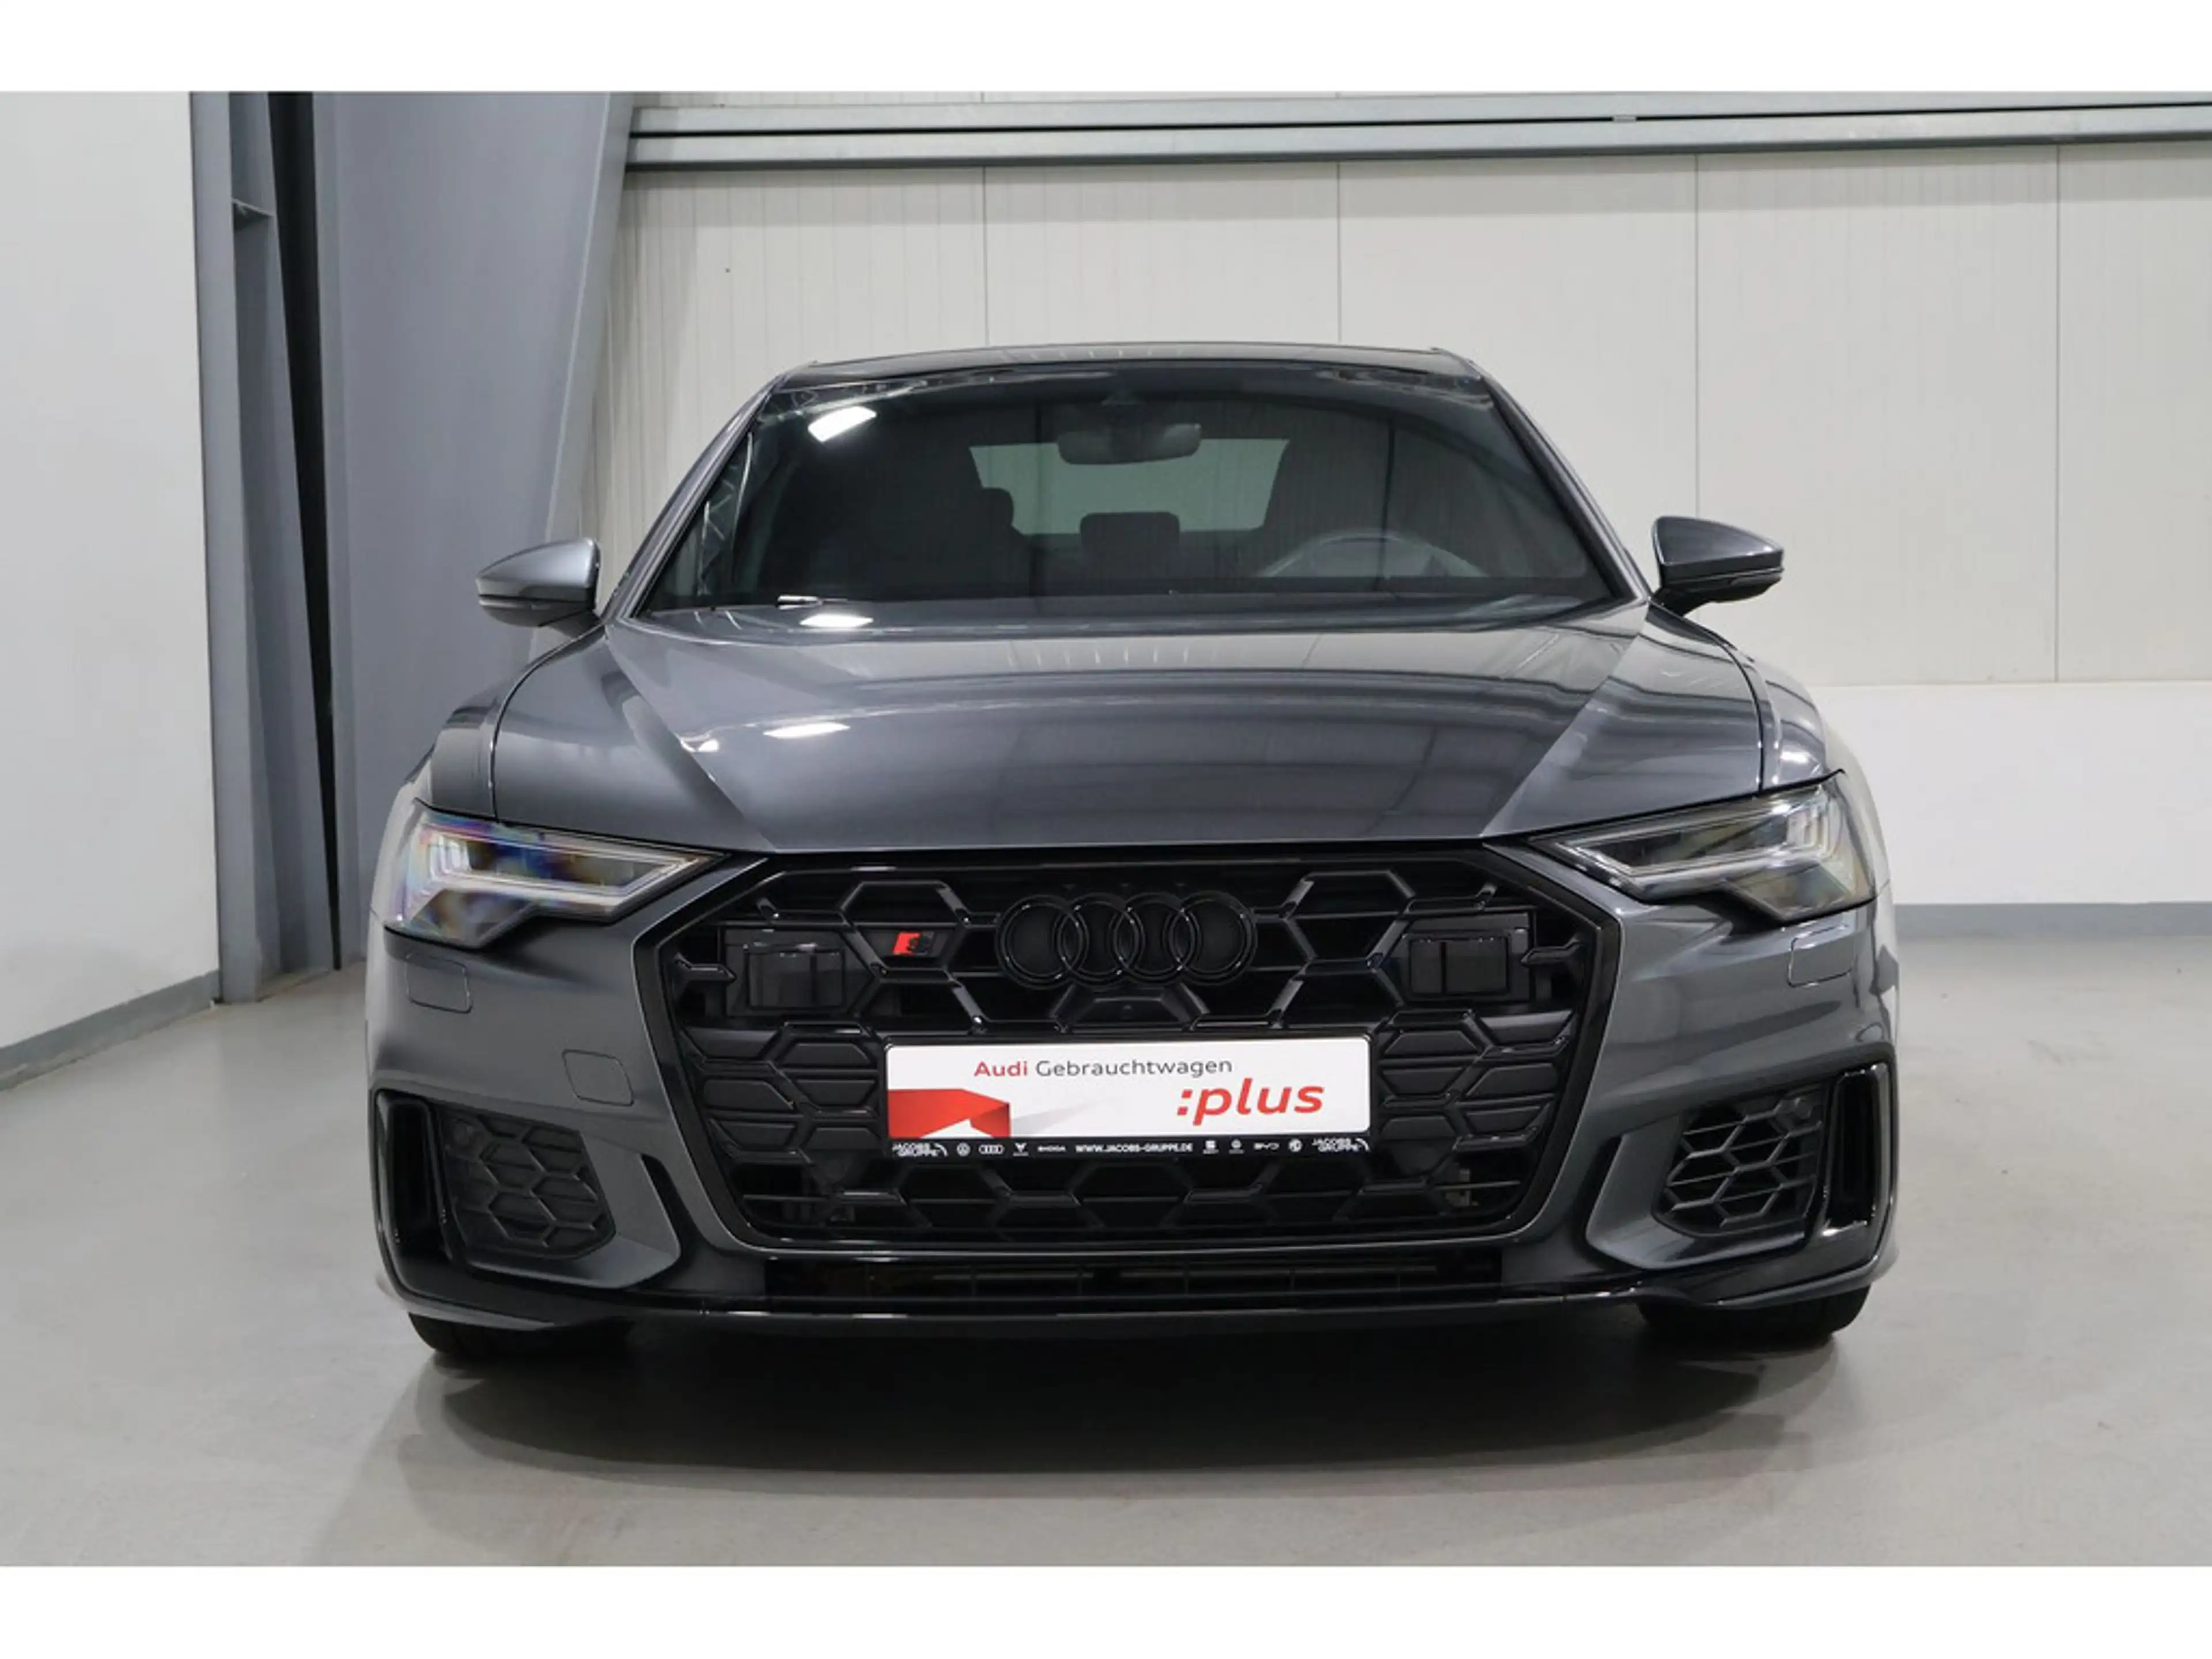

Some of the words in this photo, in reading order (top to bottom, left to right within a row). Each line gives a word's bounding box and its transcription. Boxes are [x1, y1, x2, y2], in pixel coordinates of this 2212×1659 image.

[974, 1060, 1028, 1077] Audi
[1035, 1058, 1233, 1080] Gebrauchtwagen
[1177, 1078, 1325, 1126] :plus
[1075, 1143, 1193, 1152] WWW.JACOBS-GRUPPE.DE
